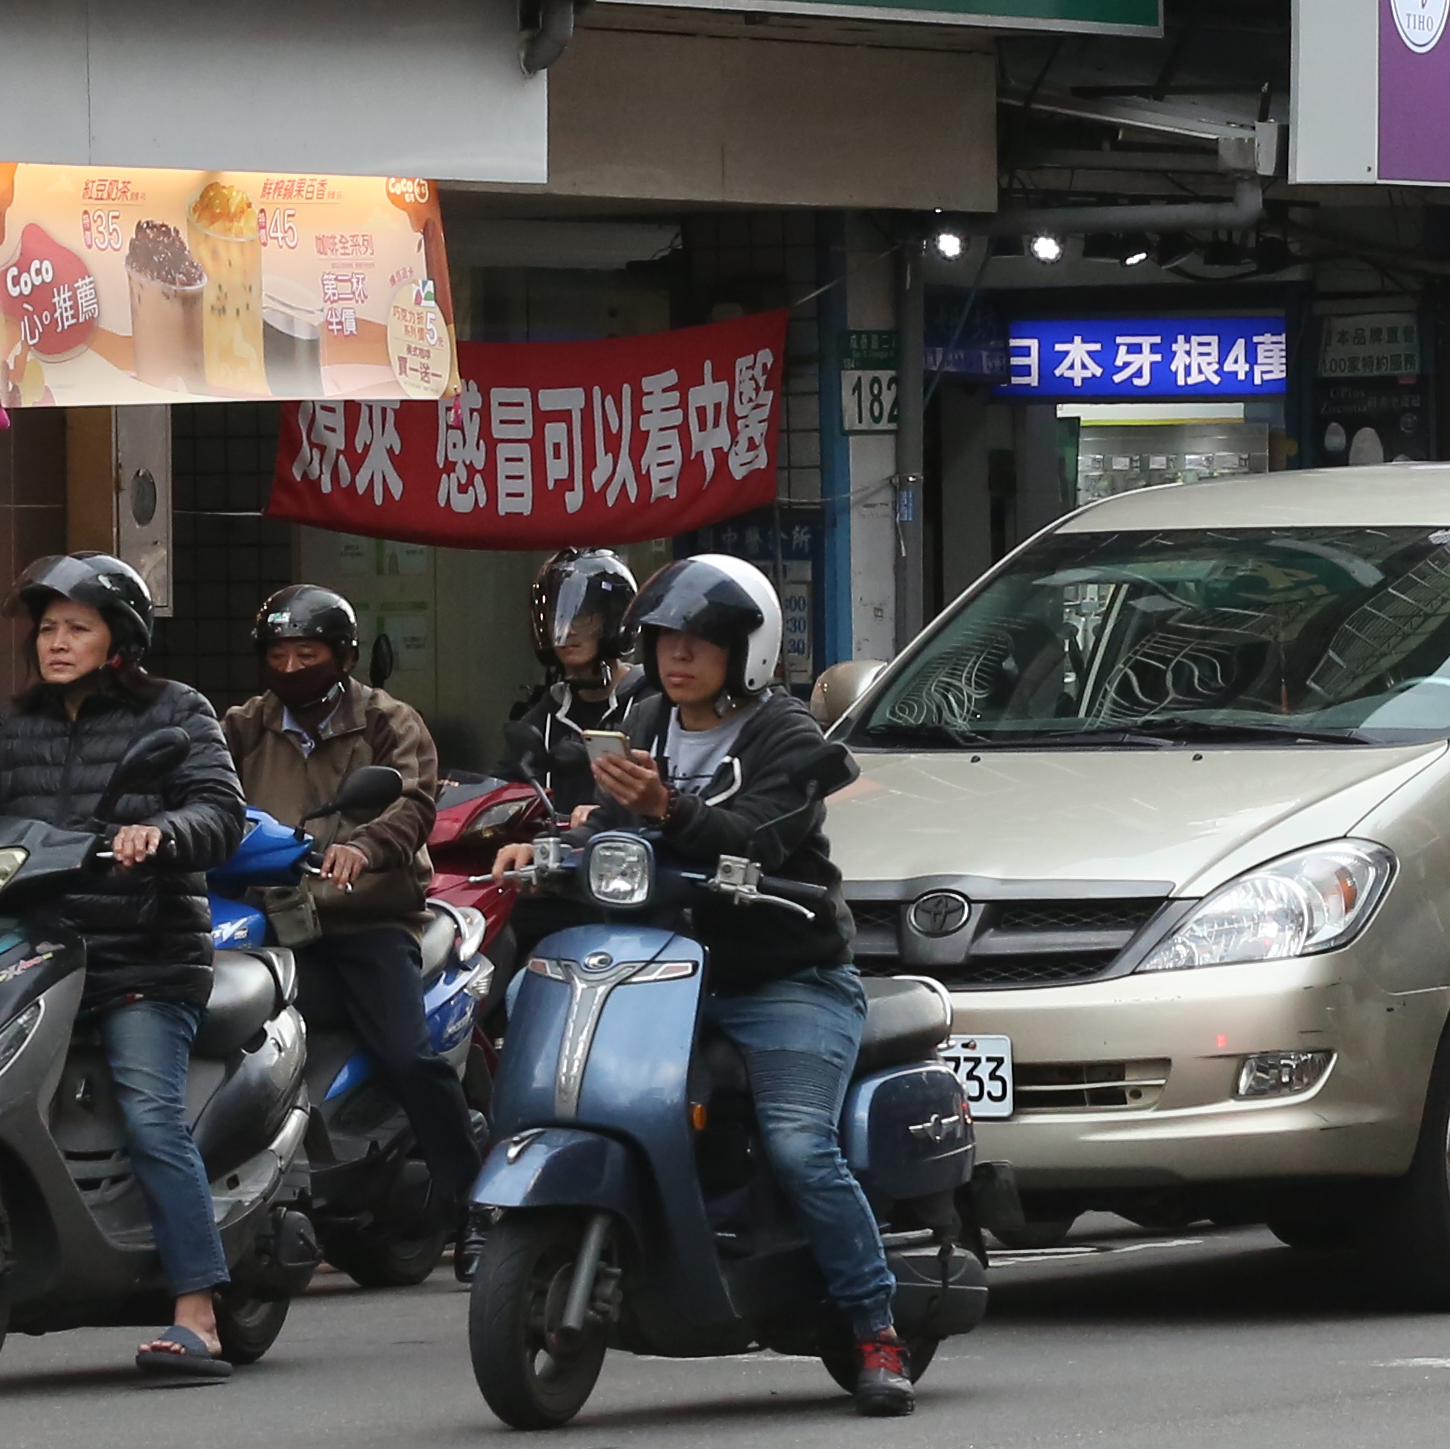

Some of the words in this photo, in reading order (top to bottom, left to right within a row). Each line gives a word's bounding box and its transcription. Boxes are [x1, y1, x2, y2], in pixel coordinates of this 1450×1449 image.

[1405, 11, 1434, 33] TIHO
[92, 208, 122, 252] 35
[268, 207, 299, 250] 45
[321, 271, 369, 304] 第二杯
[326, 306, 358, 338] 半價
[436, 348, 775, 516] 感冒可以看中醫
